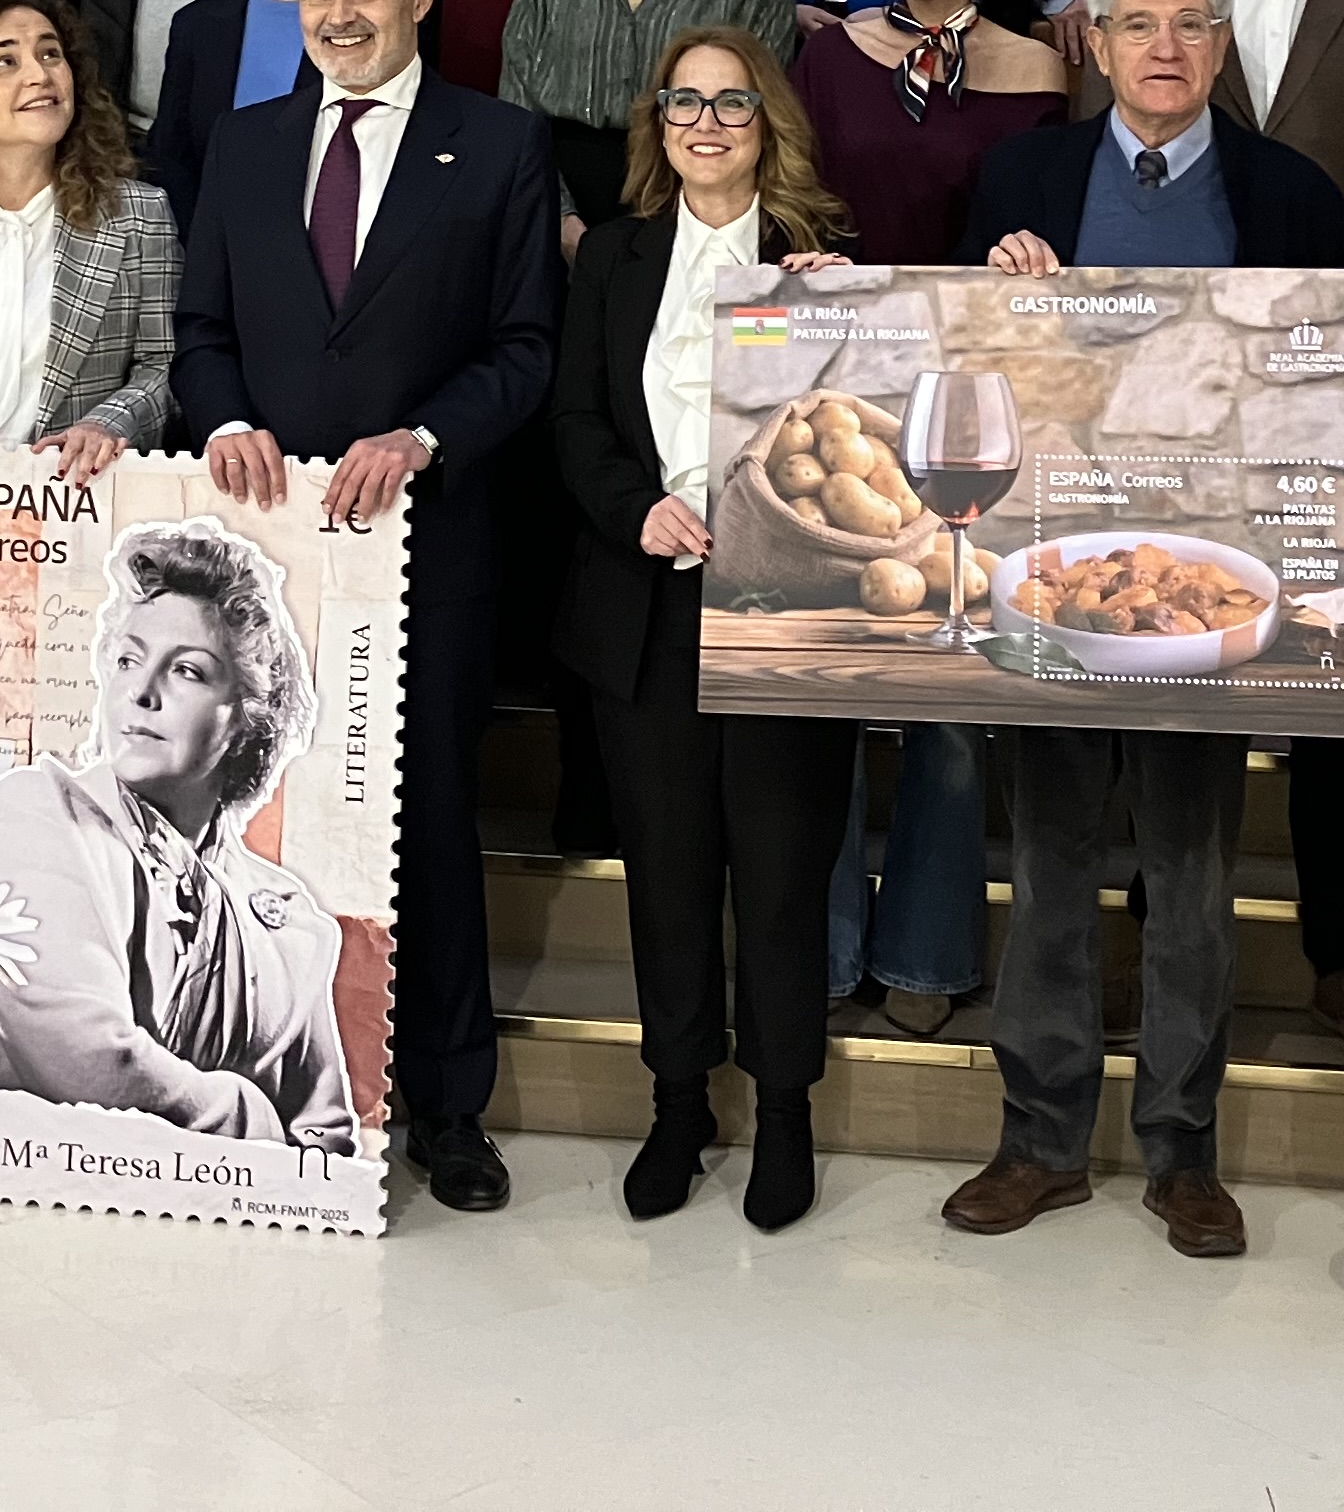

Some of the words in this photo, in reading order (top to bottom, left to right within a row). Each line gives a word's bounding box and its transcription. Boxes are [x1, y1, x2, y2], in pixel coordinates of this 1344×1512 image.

[1009, 292, 1157, 314] GASTRONOMÍA
[793, 307, 812, 320] LA
[815, 307, 857, 320] RIOJA
[793, 328, 846, 340] PATATAS
[848, 329, 857, 340] A
[859, 329, 875, 340] LA
[877, 328, 930, 341] RIOJANA
[1269, 353, 1294, 362] REAL
[1297, 353, 1344, 363] ACADEMIA
[1267, 362, 1279, 372] DE
[1049, 468, 1114, 487] ESPAÑA
[1121, 472, 1184, 489] Correos
[1276, 475, 1318, 495] 4,60
[1321, 476, 1336, 494] €
[1048, 492, 1130, 505] GASTRONOMÍA
[1282, 504, 1336, 515] PATATAS
[1254, 515, 1264, 525] A
[1266, 515, 1281, 525] LA
[1283, 515, 1336, 527] RIOJANA
[1283, 538, 1298, 548] LA
[1301, 538, 1337, 549] RIOJA
[1282, 557, 1322, 570] ESPAÑA
[1324, 559, 1339, 570] EN
[1282, 569, 1295, 580] 19
[1296, 570, 1336, 581] PLATOS
[345, 622, 371, 804] LITERATURA
[0, 1137, 49, 1169] Mª
[58, 1142, 161, 1180] Teresa
[173, 1151, 255, 1188] León
[247, 1201, 318, 1218] RCM-FNMT
[321, 1209, 350, 1222] 2025
